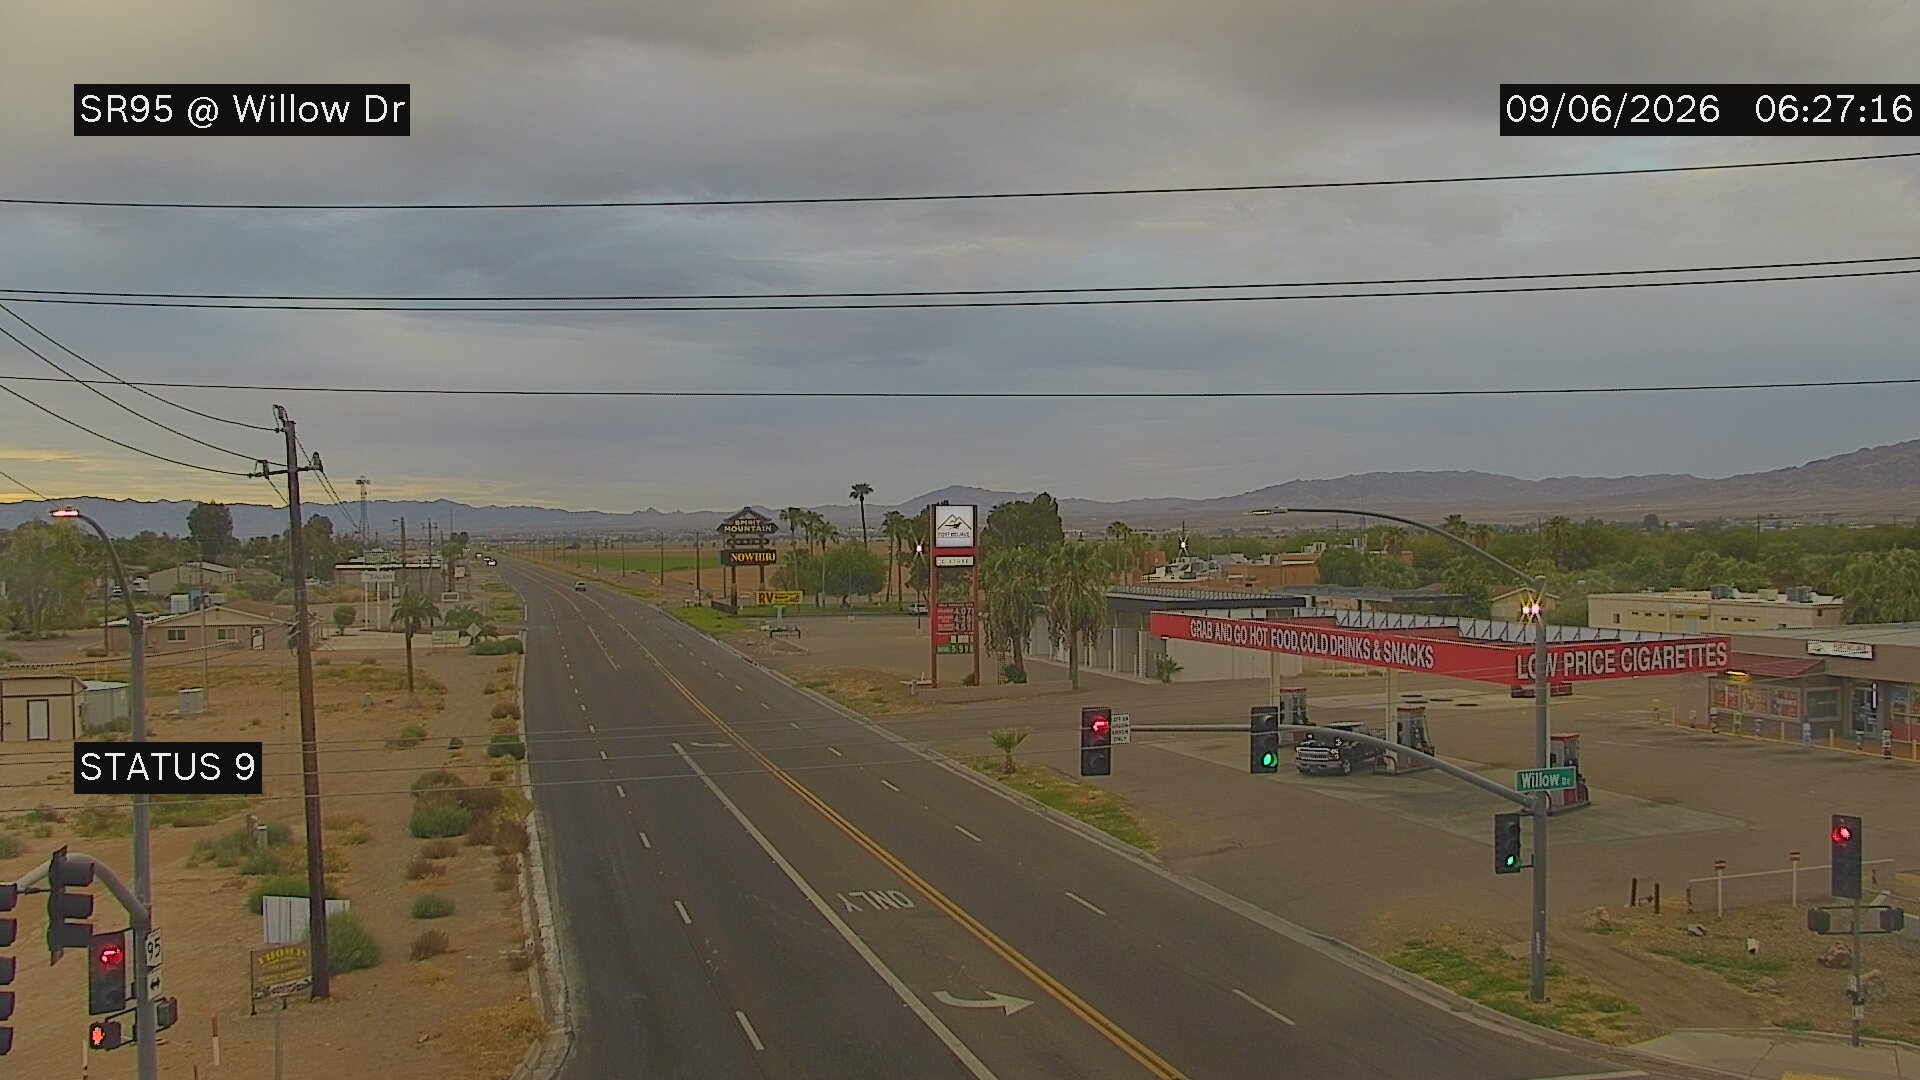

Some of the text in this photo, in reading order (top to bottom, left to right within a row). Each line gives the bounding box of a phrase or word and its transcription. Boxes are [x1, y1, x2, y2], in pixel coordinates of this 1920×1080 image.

[724, 525, 772, 533] MOUNTAIN
[758, 592, 774, 604] RV
[1190, 618, 1213, 640] GRAB
[1214, 621, 1233, 643] AND
[1233, 624, 1248, 645] GO
[1249, 625, 1268, 647] HOT
[1330, 634, 1371, 661] DRINKS
[1372, 642, 1382, 661] &
[1382, 639, 1434, 669] SNACKS
[1563, 649, 1616, 677] PRICE
[1620, 642, 1728, 674] CIGARETTES
[1521, 771, 1560, 789] Willow
[836, 890, 915, 913] ONLY
[147, 936, 161, 961] 95
